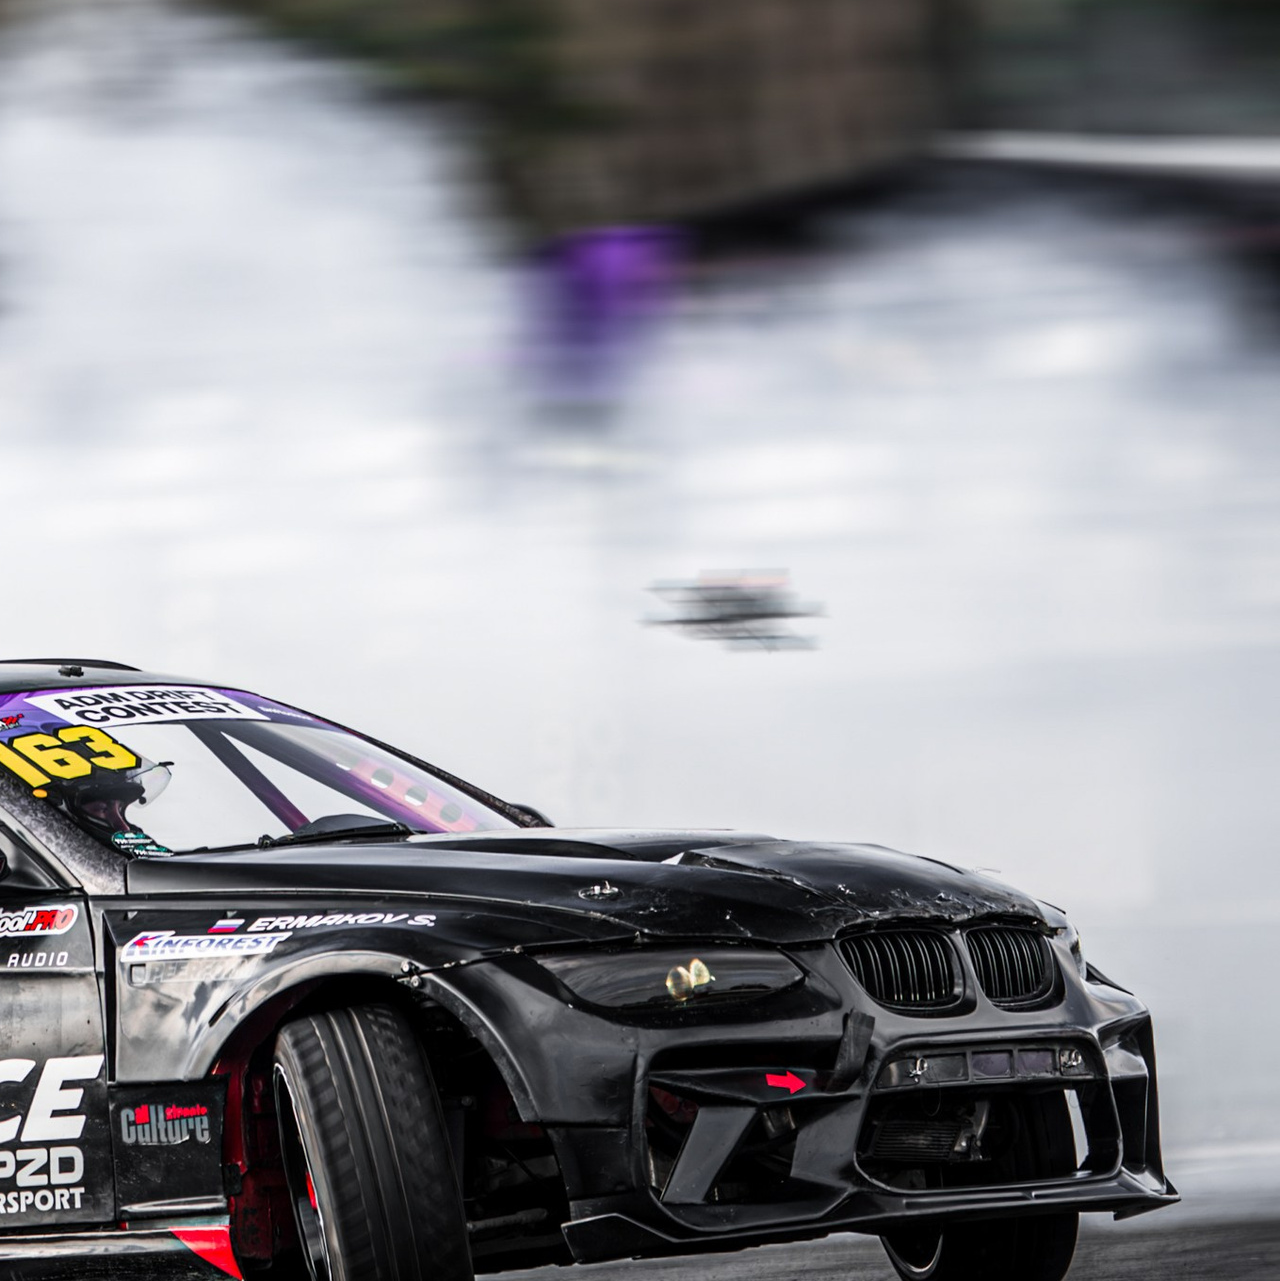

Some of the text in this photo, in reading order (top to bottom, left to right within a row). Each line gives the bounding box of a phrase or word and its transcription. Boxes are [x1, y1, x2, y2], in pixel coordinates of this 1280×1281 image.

[53, 688, 217, 710] ADM DRIFT
[74, 701, 242, 723] CONTEST
[246, 913, 409, 933] ERMAKOV
[125, 932, 284, 958] KINFOREST
[7, 951, 69, 968] AUDIO
